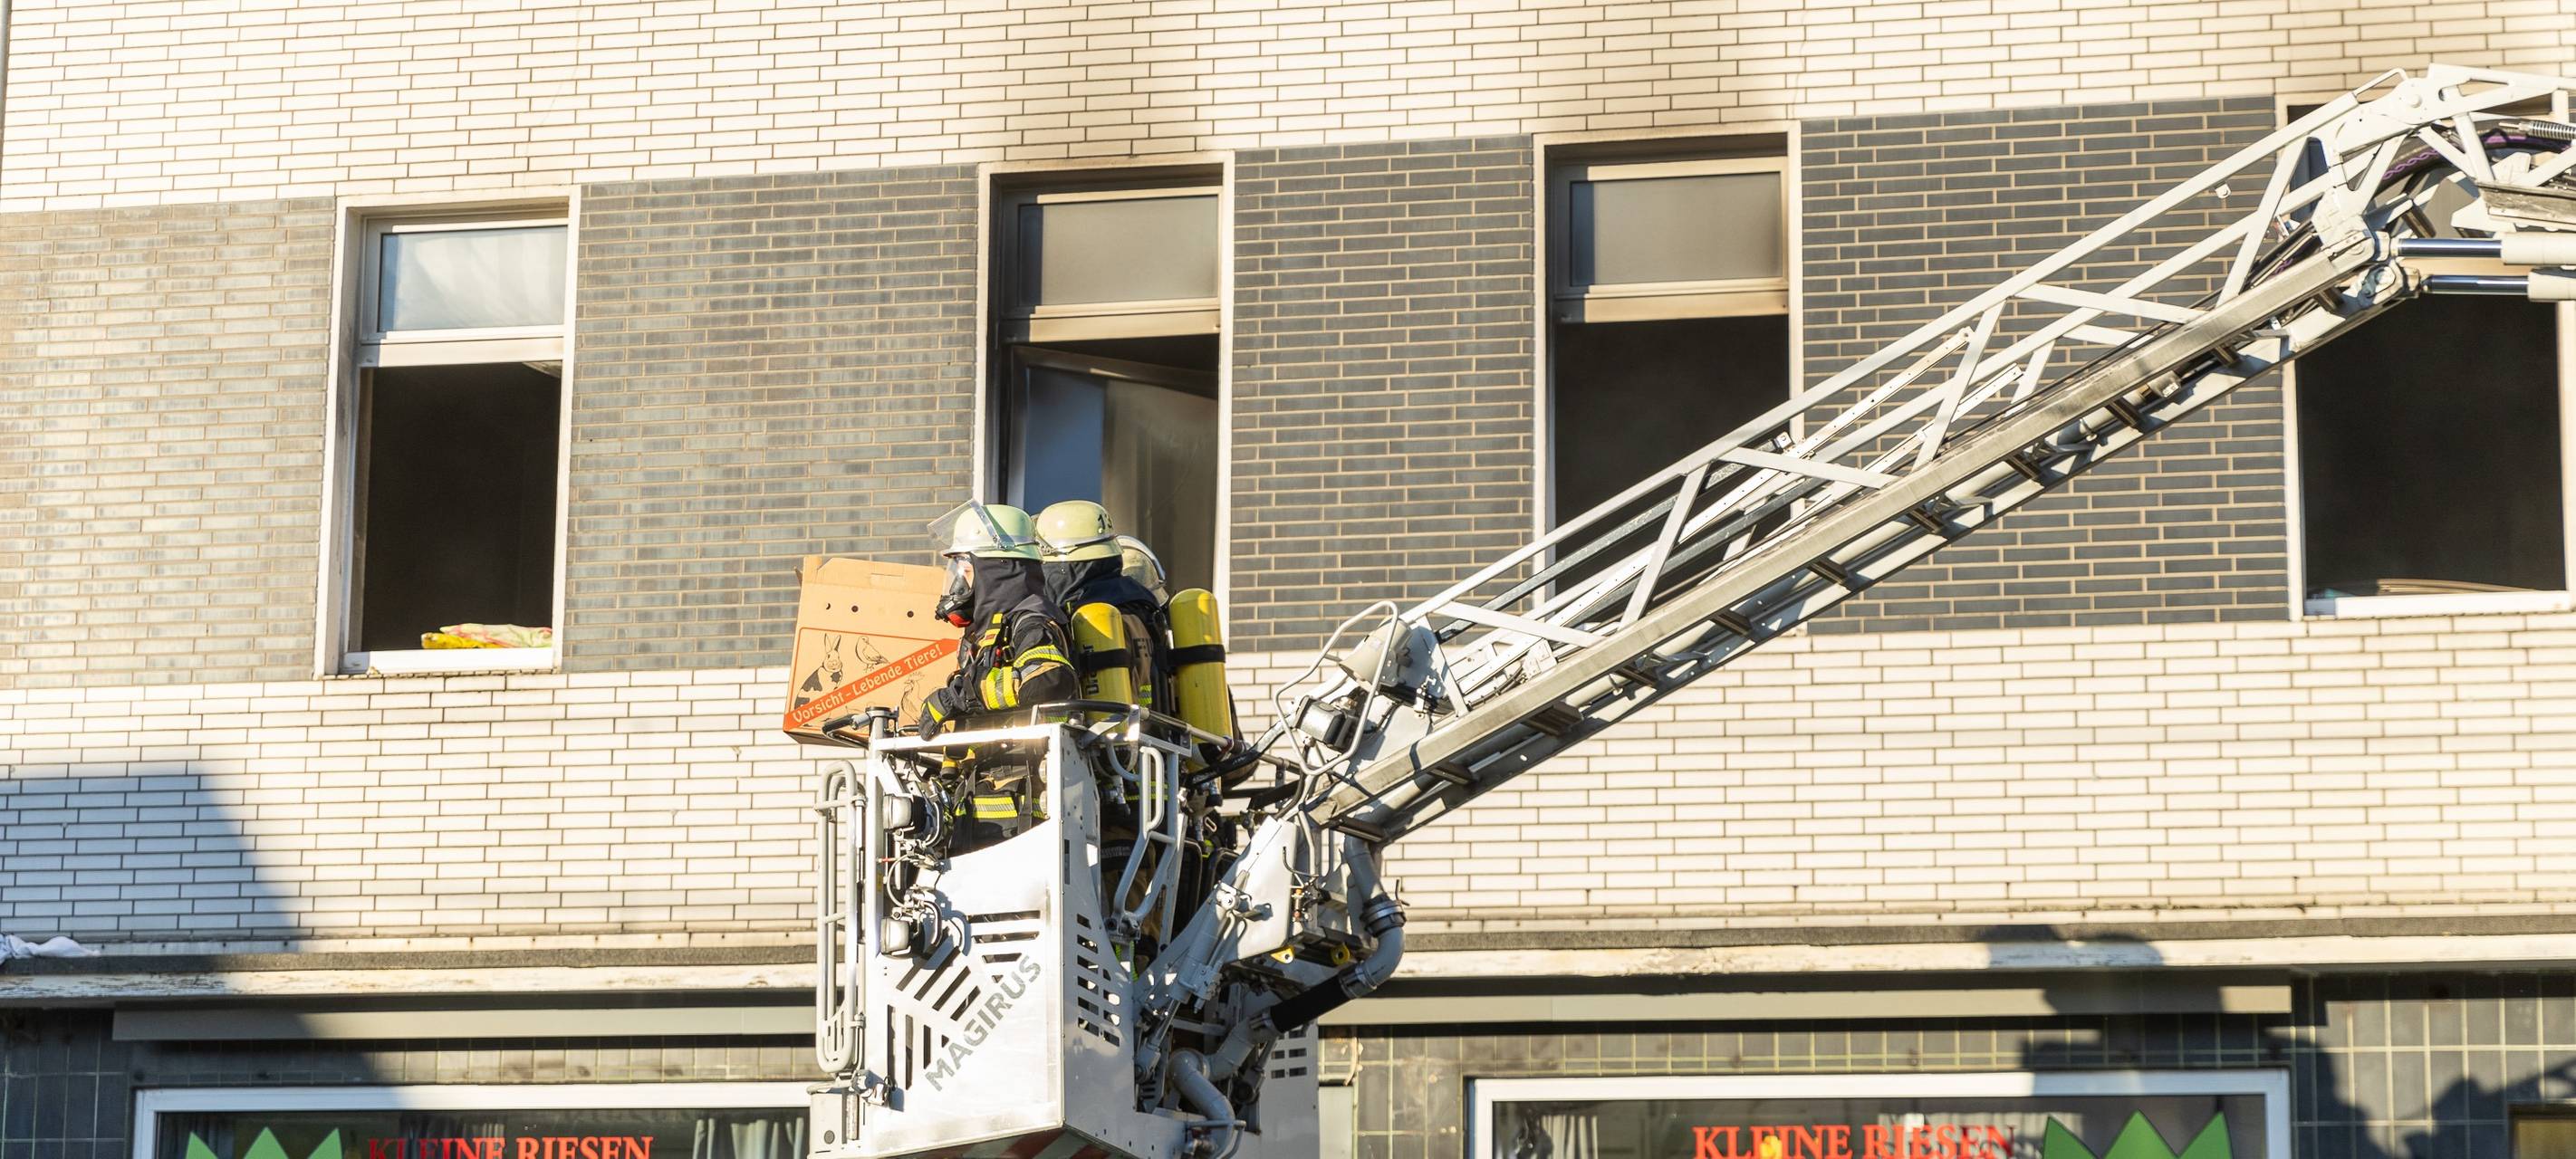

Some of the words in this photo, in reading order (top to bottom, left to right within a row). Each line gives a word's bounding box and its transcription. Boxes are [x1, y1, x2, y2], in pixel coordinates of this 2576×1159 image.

[792, 693, 845, 723] Vorsicht
[851, 664, 903, 696] Lebende
[904, 644, 944, 673] Tiere!
[925, 954, 1042, 1092] MAGIRUS
[514, 1136, 654, 1159] RIESEN
[1861, 1124, 2016, 1159] RIESEN
